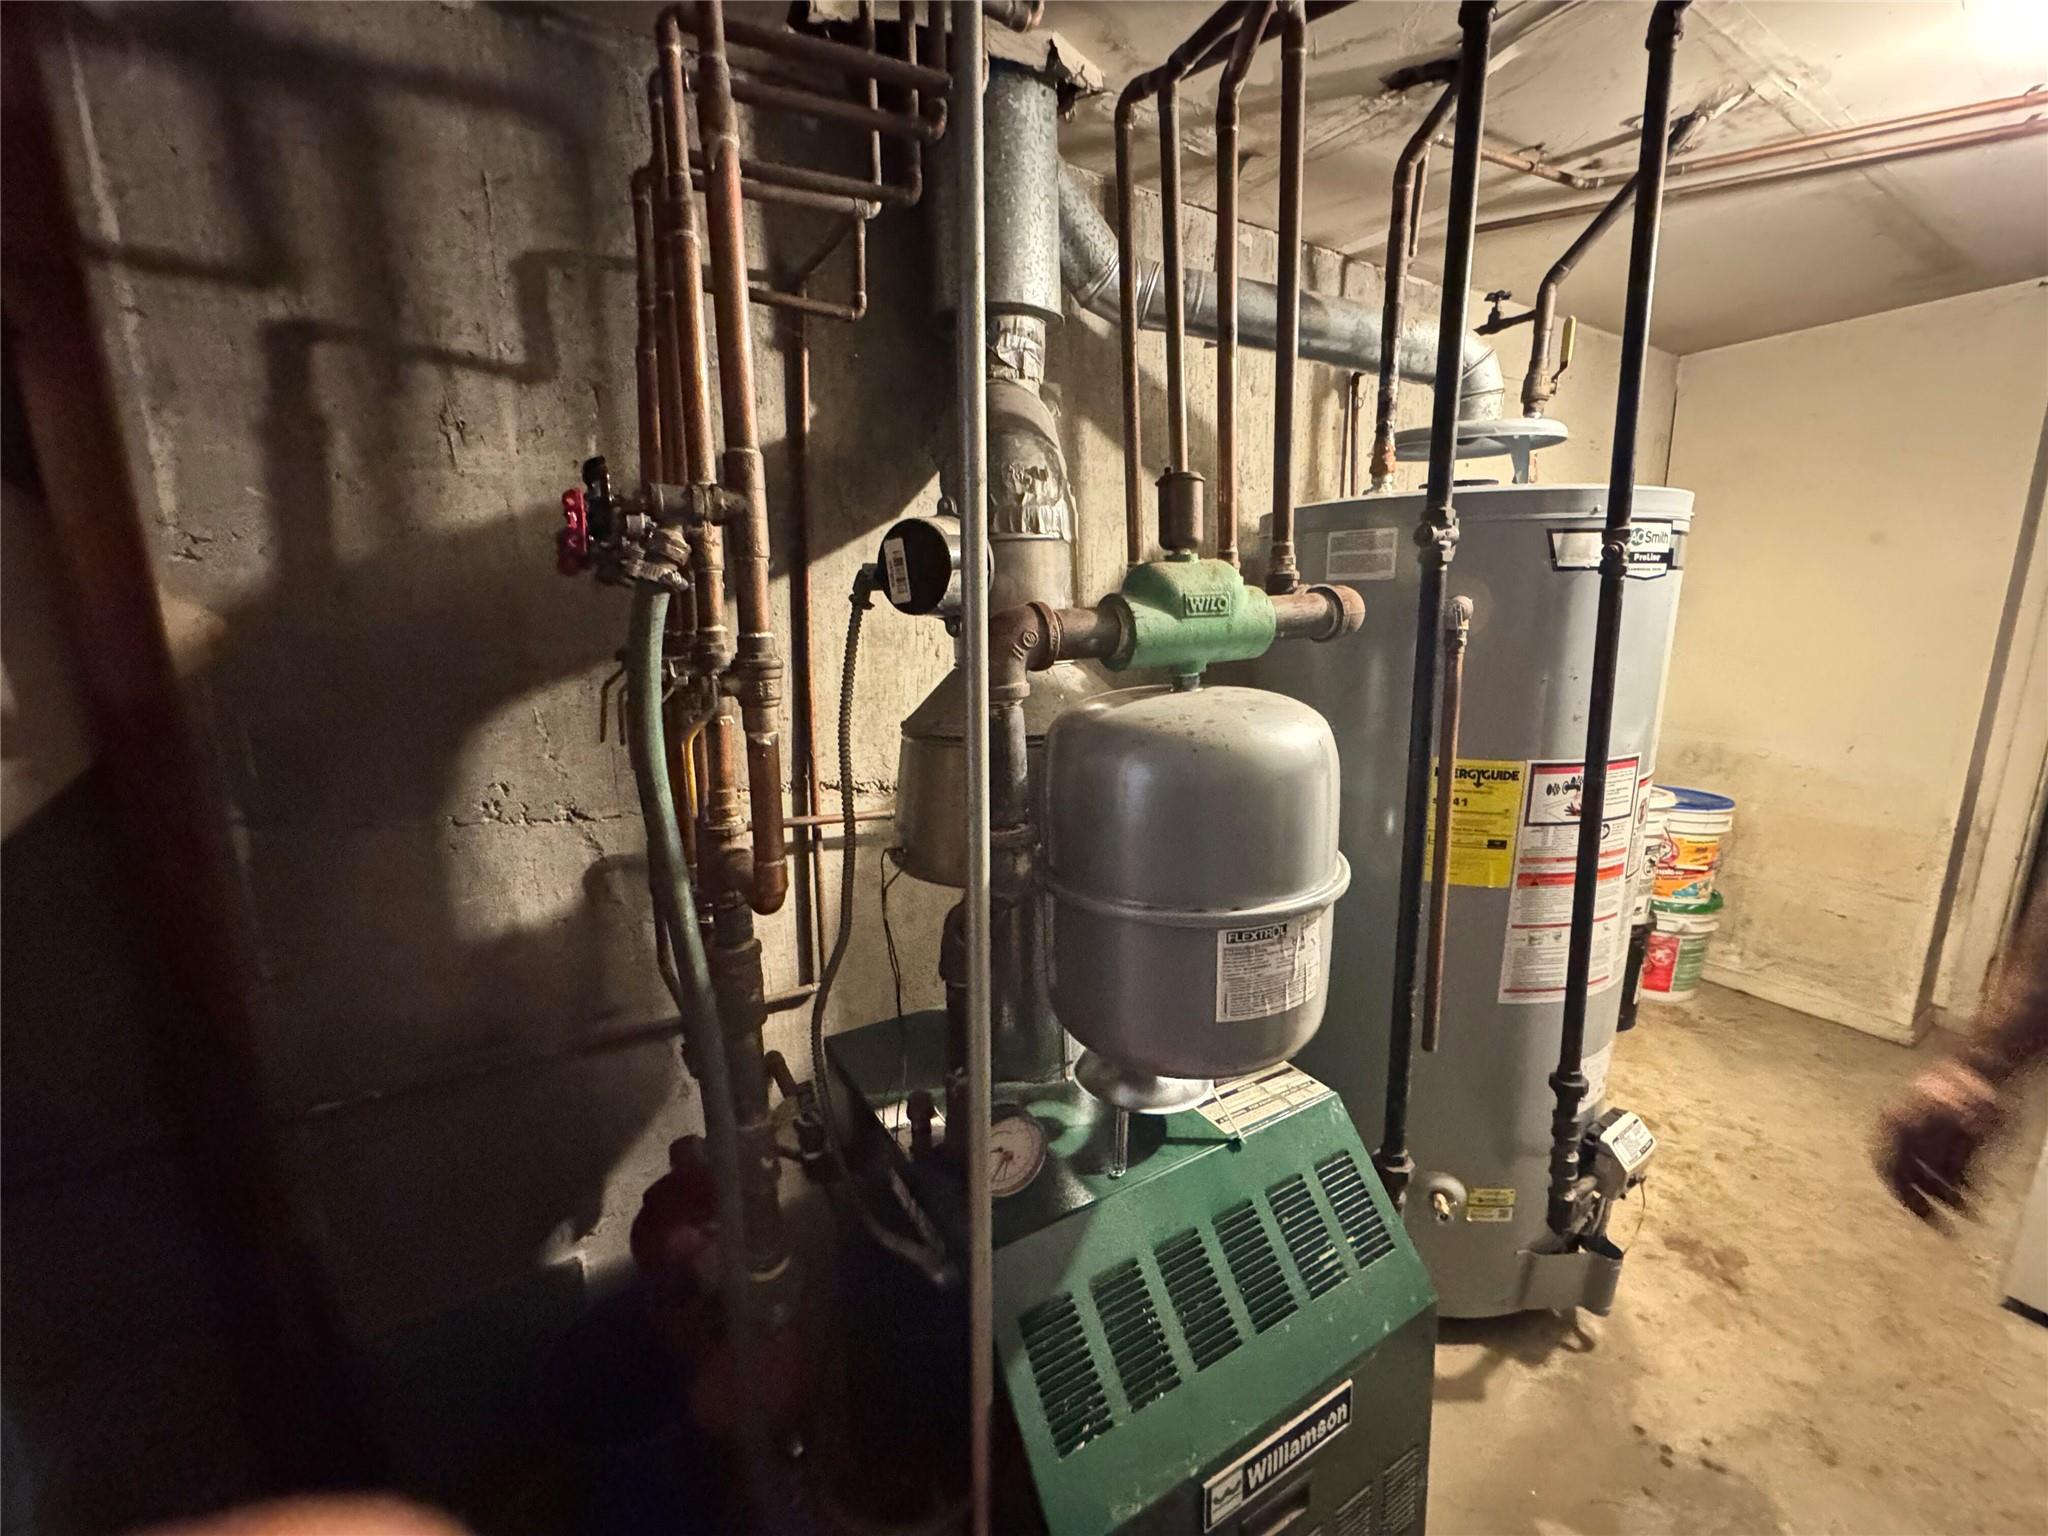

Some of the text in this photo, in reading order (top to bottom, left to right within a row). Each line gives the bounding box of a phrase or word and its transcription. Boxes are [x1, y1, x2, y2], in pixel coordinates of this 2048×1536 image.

[1645, 530, 1669, 544] Smith
[1187, 595, 1228, 613] WILO
[1435, 767, 1520, 787] ERGYGUIDE
[1228, 924, 1288, 944] FLEXTROL
[1248, 1403, 1348, 1490] Williamson
